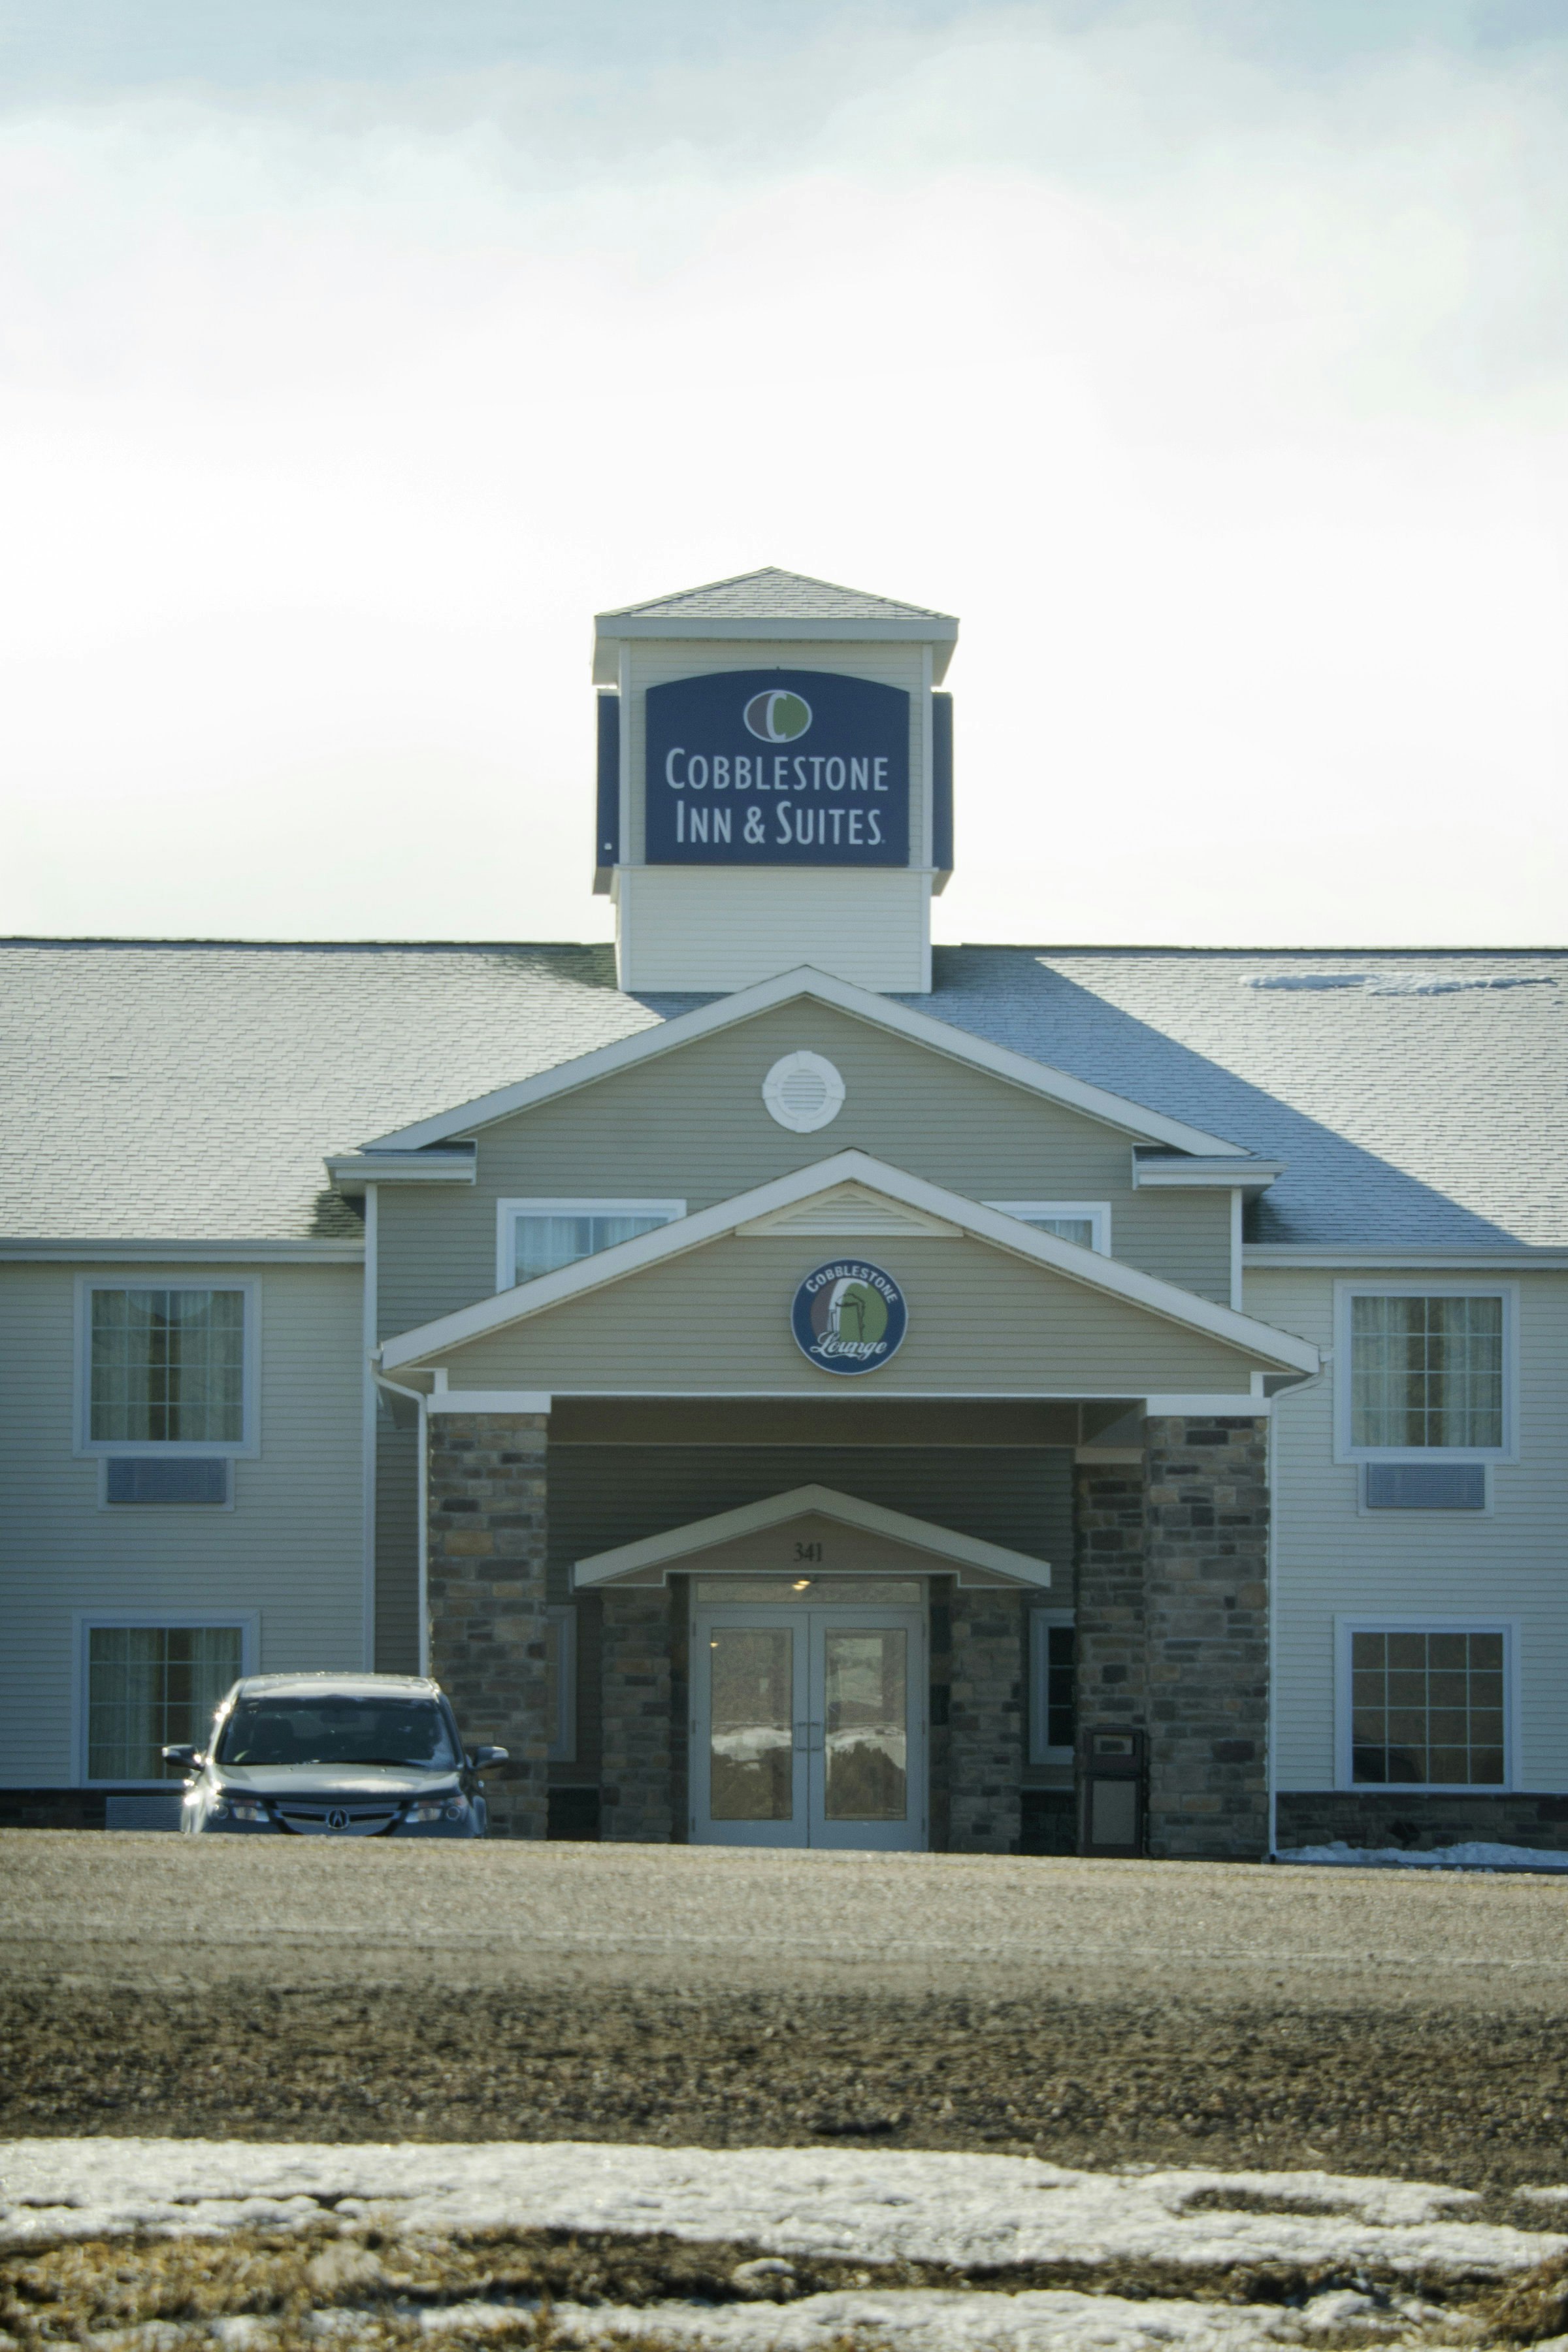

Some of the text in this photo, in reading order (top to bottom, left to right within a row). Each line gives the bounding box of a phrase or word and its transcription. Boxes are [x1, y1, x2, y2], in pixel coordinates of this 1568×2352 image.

[665, 747, 889, 791] COBBLESTONE
[676, 800, 882, 845] INN & SUITES
[806, 1266, 898, 1303] COBBLESTONE
[809, 1331, 888, 1361] Lounge
[793, 1542, 822, 1562] 341
